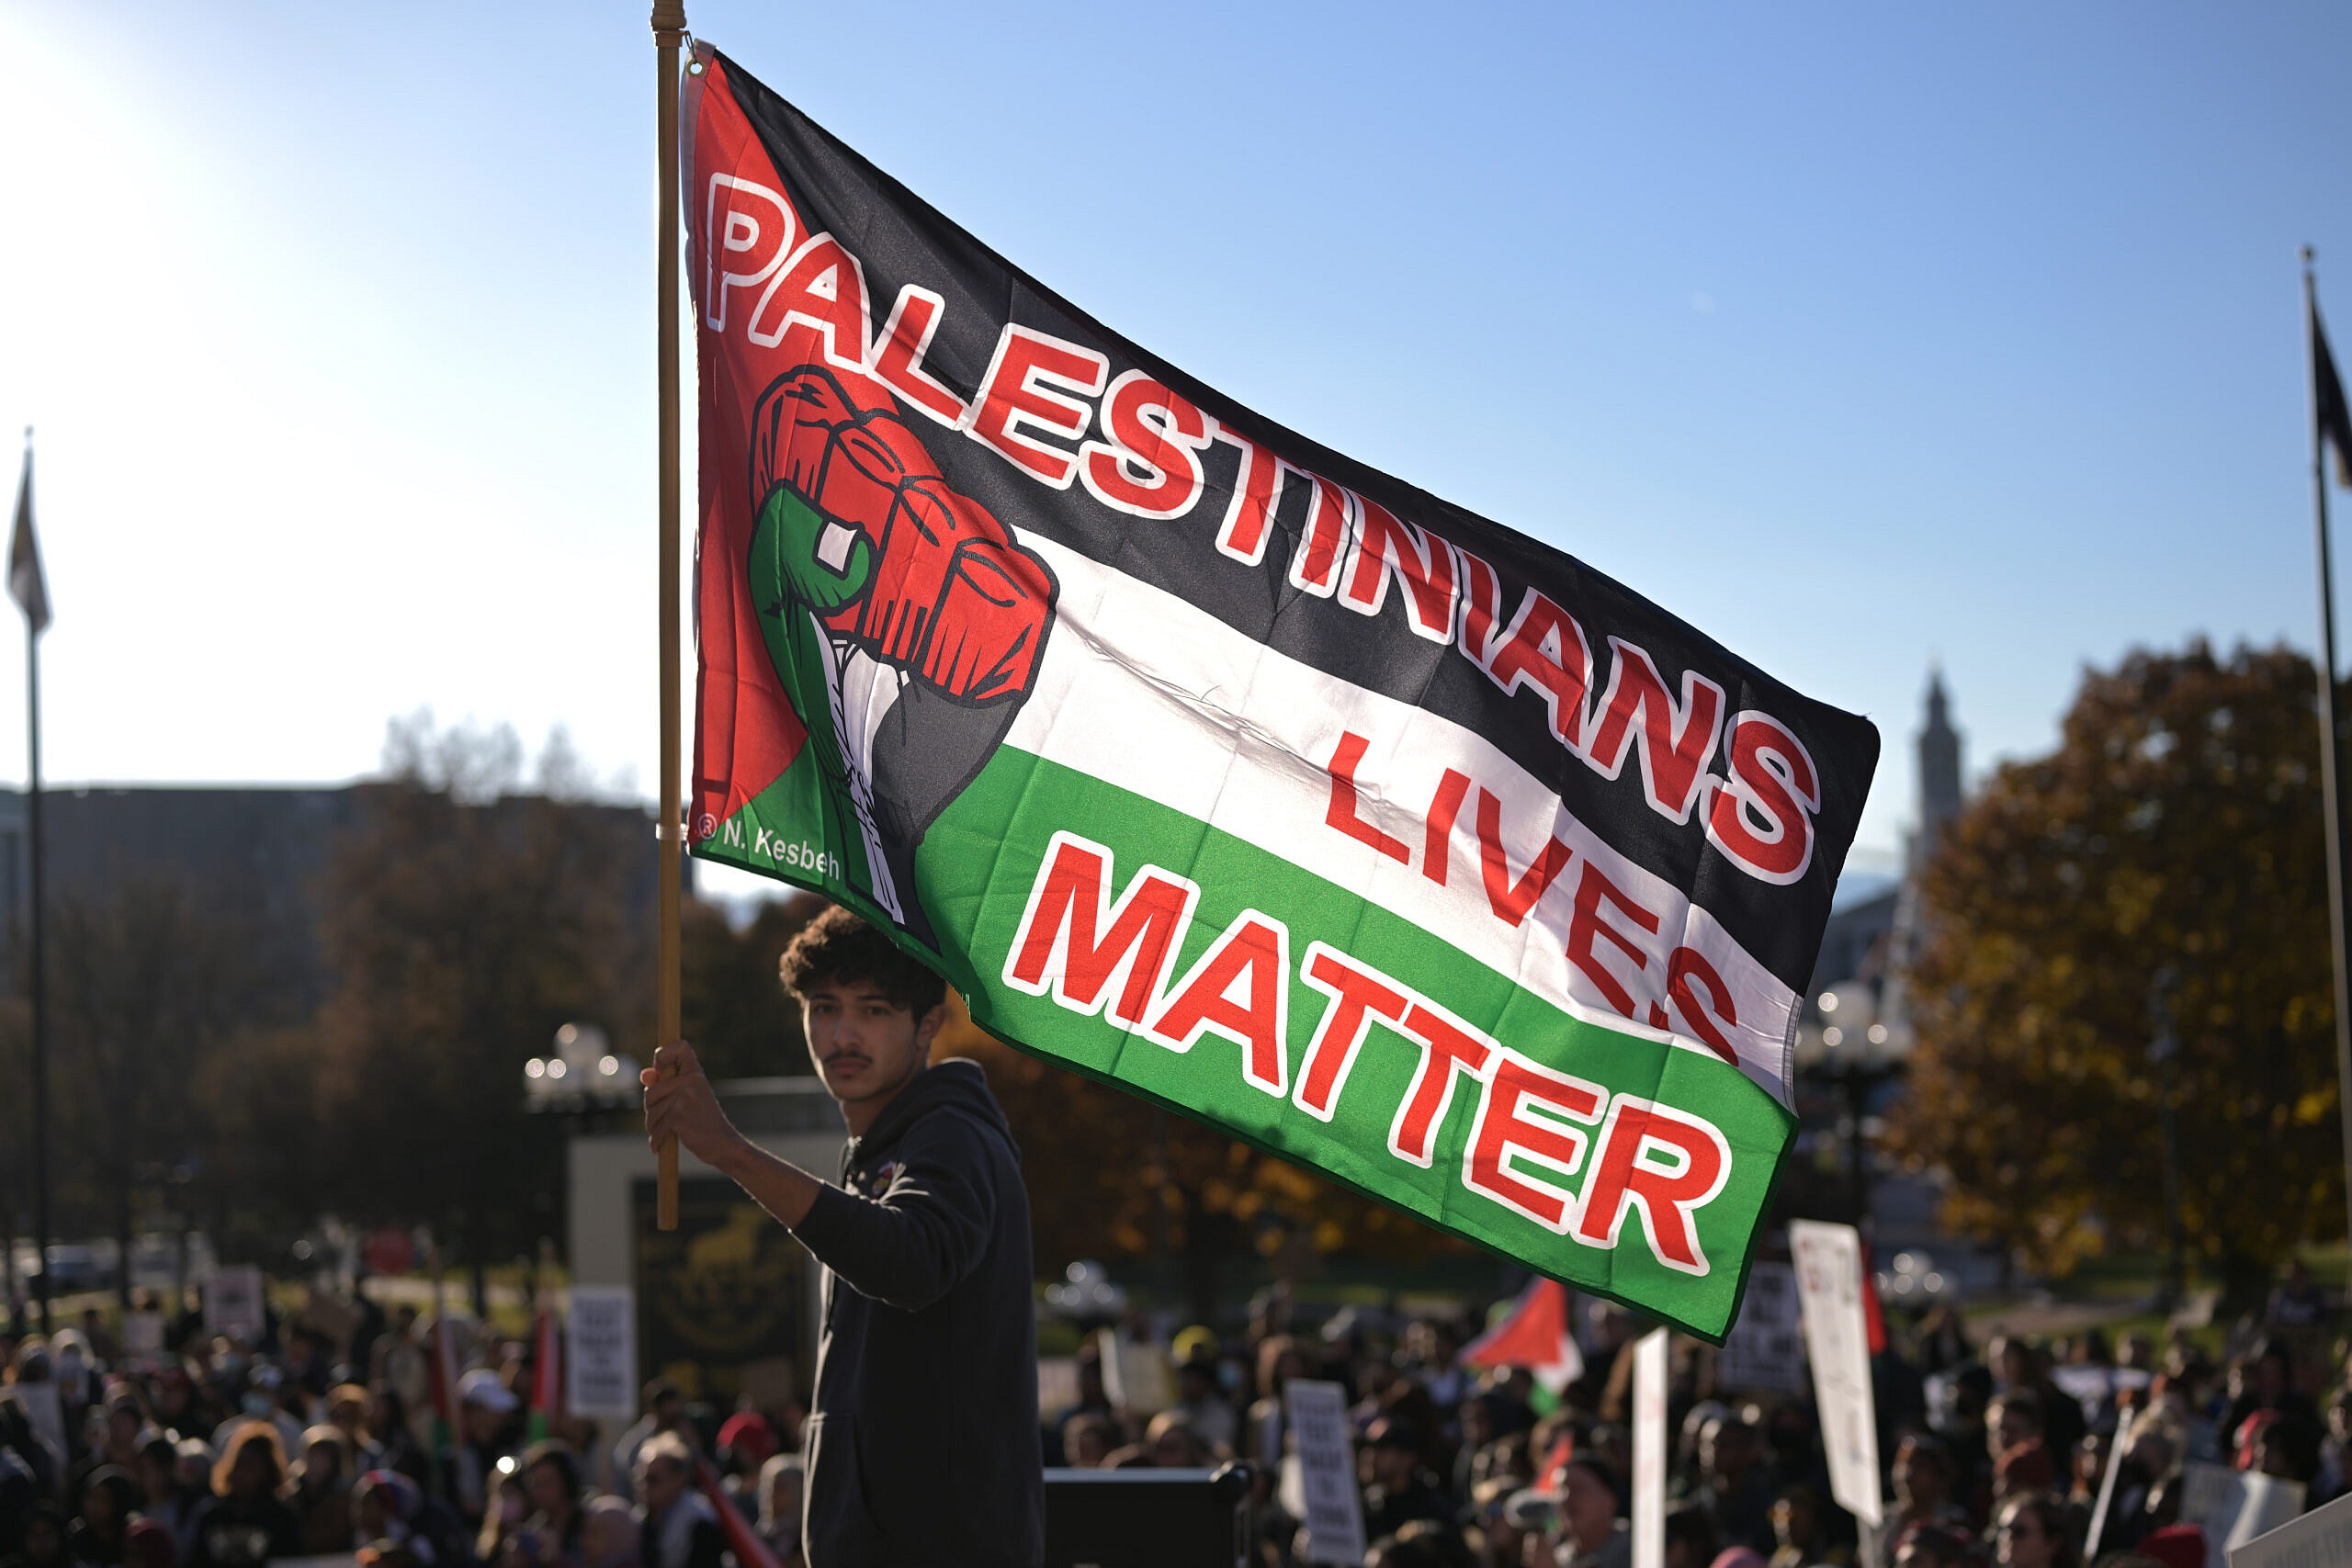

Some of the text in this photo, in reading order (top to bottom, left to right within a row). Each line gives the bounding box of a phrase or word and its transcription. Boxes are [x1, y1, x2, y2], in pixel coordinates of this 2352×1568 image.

[706, 172, 1821, 886] PALESTINIANS
[723, 818, 746, 850] N.
[754, 827, 840, 880] Kesbeh
[1325, 730, 1740, 1067] LIVES
[1002, 829, 1733, 1277] MATTER
